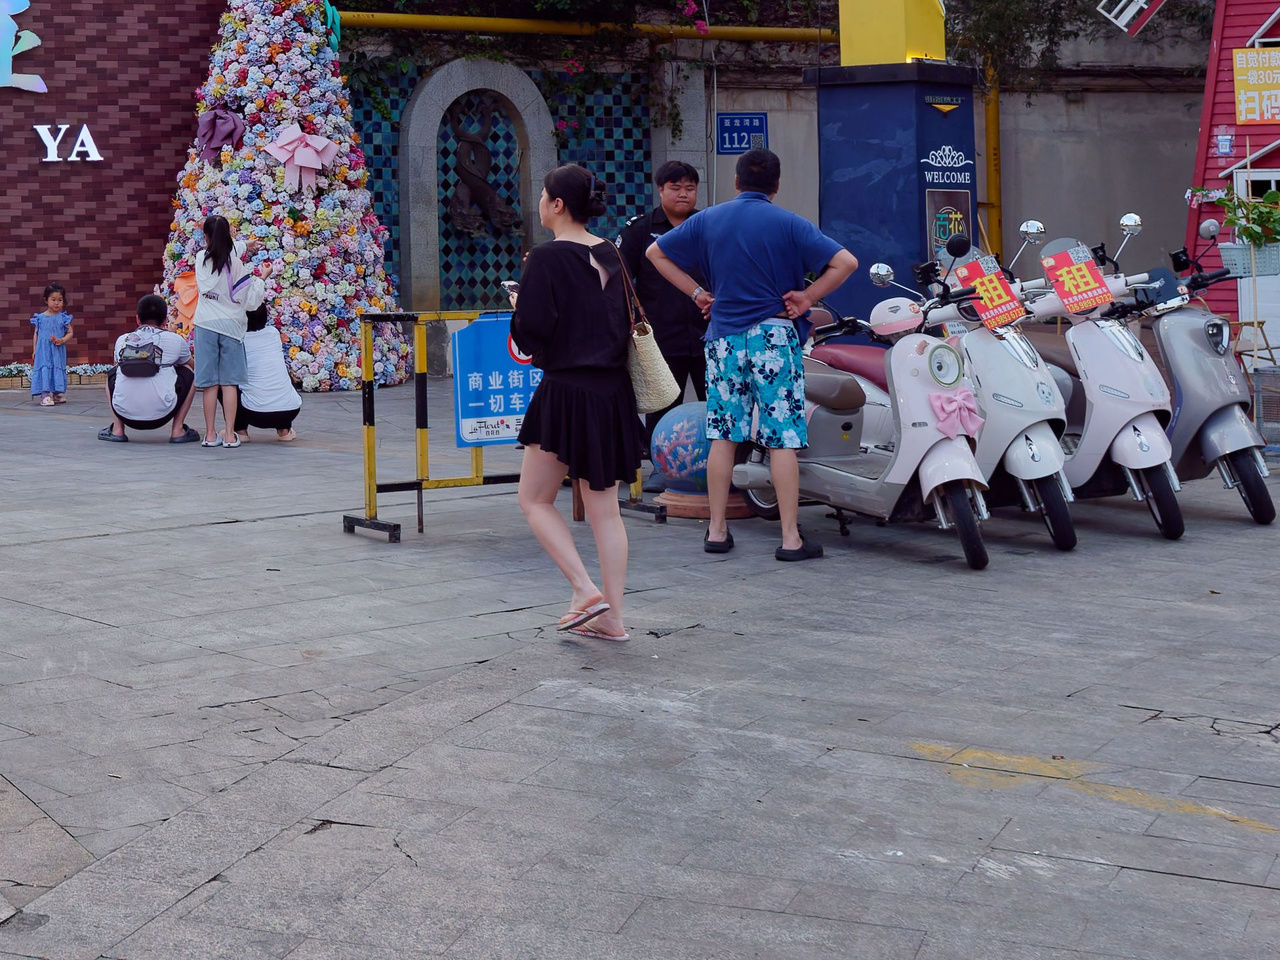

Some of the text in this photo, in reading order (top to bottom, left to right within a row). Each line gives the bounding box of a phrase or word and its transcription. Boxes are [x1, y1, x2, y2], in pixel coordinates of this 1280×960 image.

[1236, 51, 1280, 68] 自觉付款
[1237, 70, 1280, 84] 一袋30元
[1238, 89, 1280, 121] 扫码
[723, 118, 760, 127] 亚龙湾路
[34, 124, 105, 162] YA
[723, 132, 750, 148] 112
[924, 171, 971, 184] WELCOME
[1055, 263, 1100, 296] 租
[970, 274, 1011, 310] 租
[468, 369, 542, 391] 商业街区
[469, 392, 534, 413] 一切车
